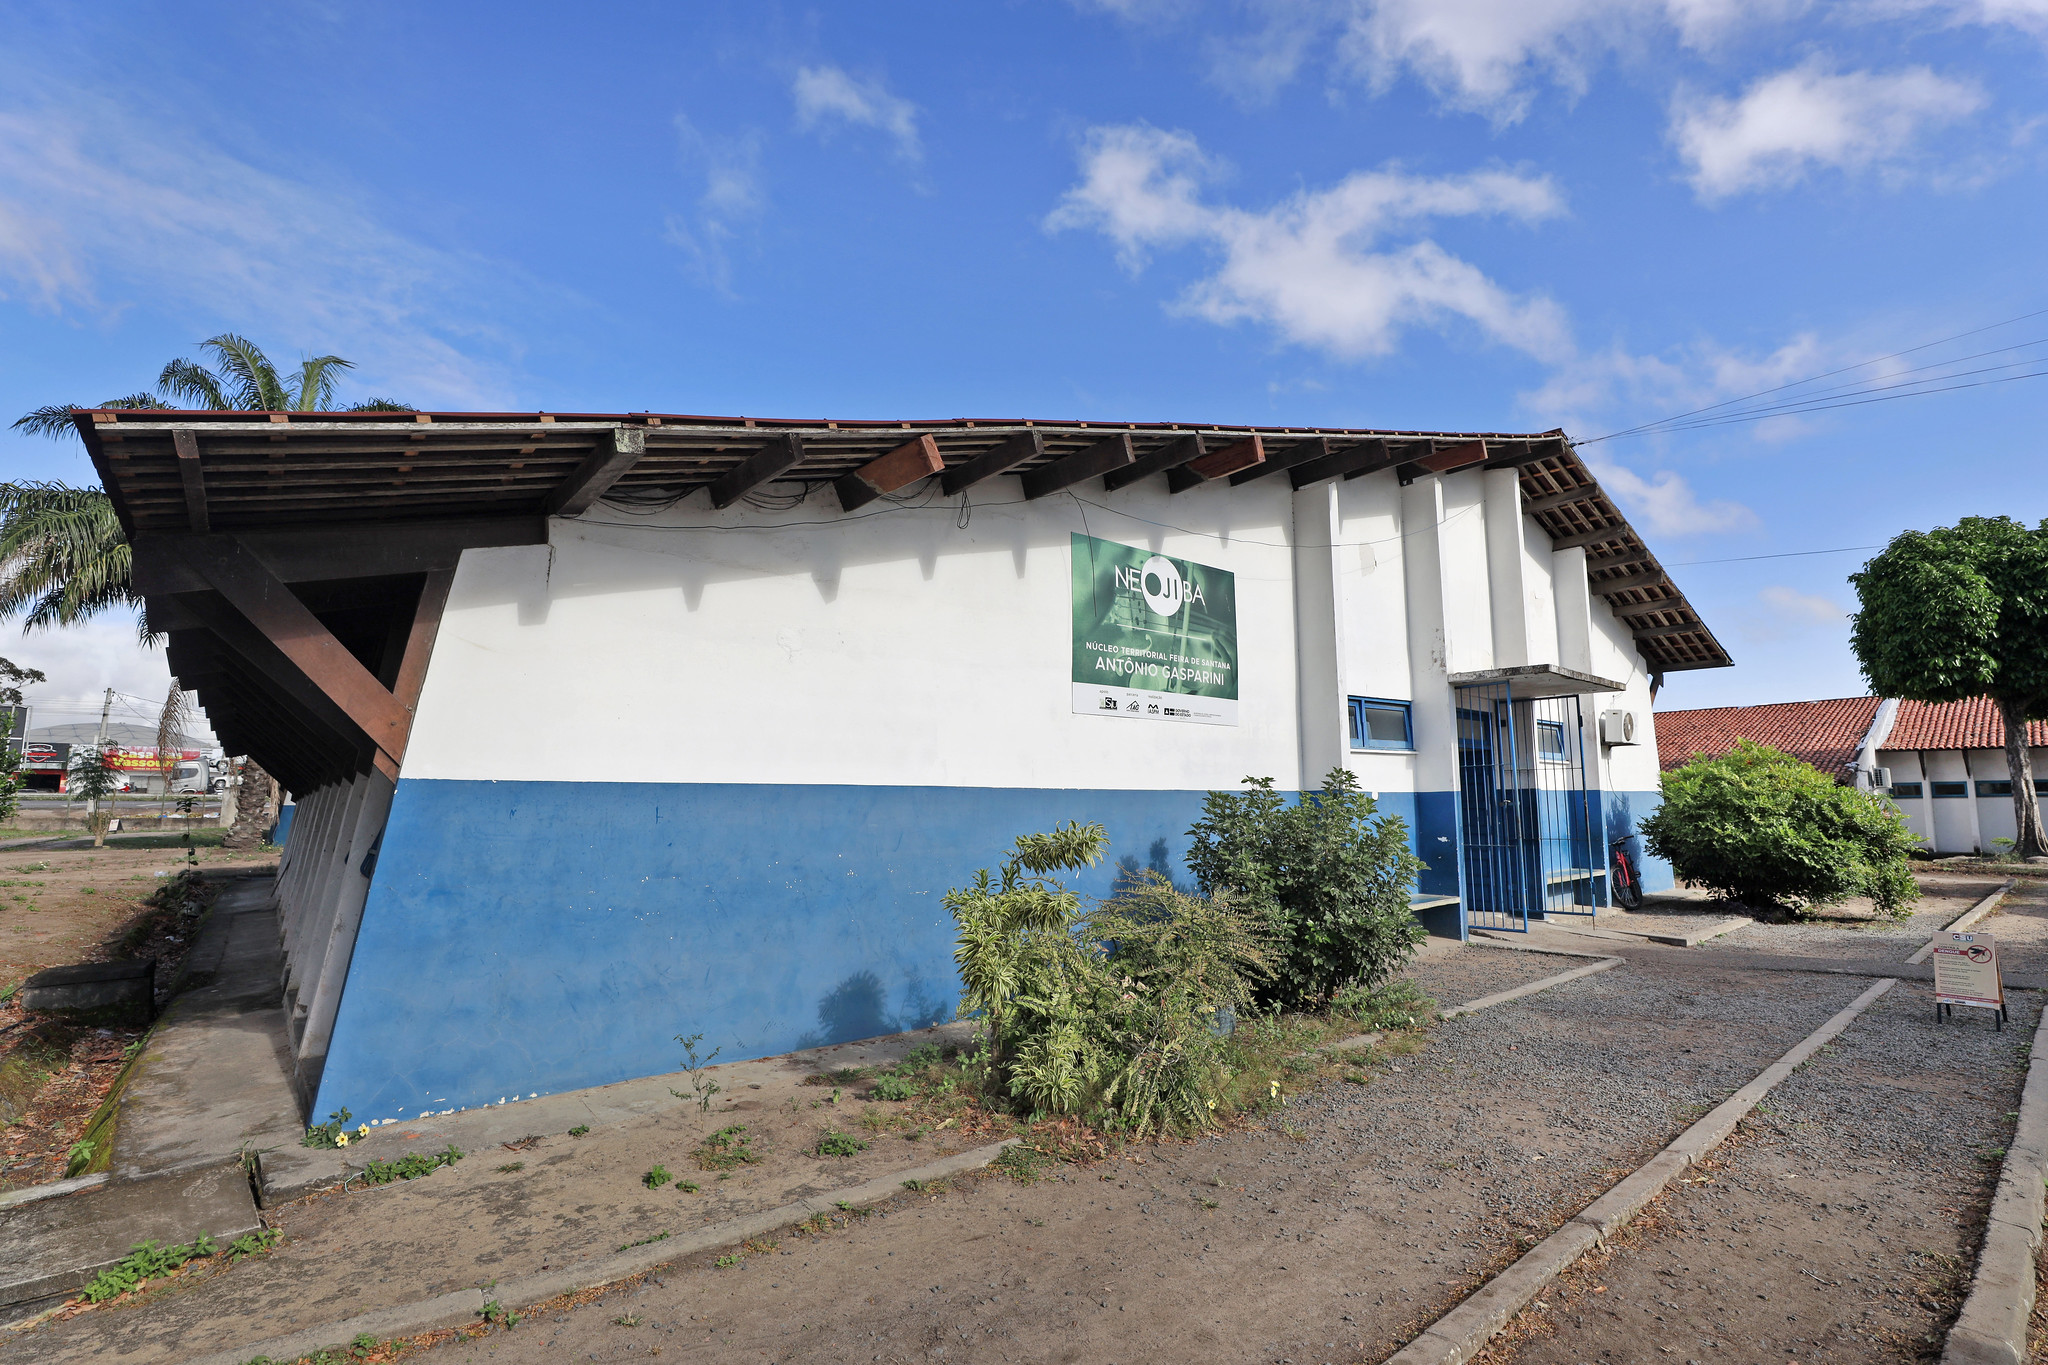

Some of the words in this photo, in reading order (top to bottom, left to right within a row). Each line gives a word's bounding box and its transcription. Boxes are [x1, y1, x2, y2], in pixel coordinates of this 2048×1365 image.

[1115, 564, 1206, 607] NEOJIBA
[1086, 641, 1118, 653] NÚCLEO
[1121, 646, 1168, 661] TERRITORIAL
[1169, 654, 1190, 664] FEIRA
[1190, 657, 1200, 666] DE
[1201, 658, 1231, 670] SANTANA
[1095, 656, 1159, 677] ANTÔNIO
[1161, 664, 1225, 686] GASPARINI
[112, 758, 174, 767] Vassour
[118, 749, 154, 759] Casa
[1953, 933, 1973, 941] CSU
